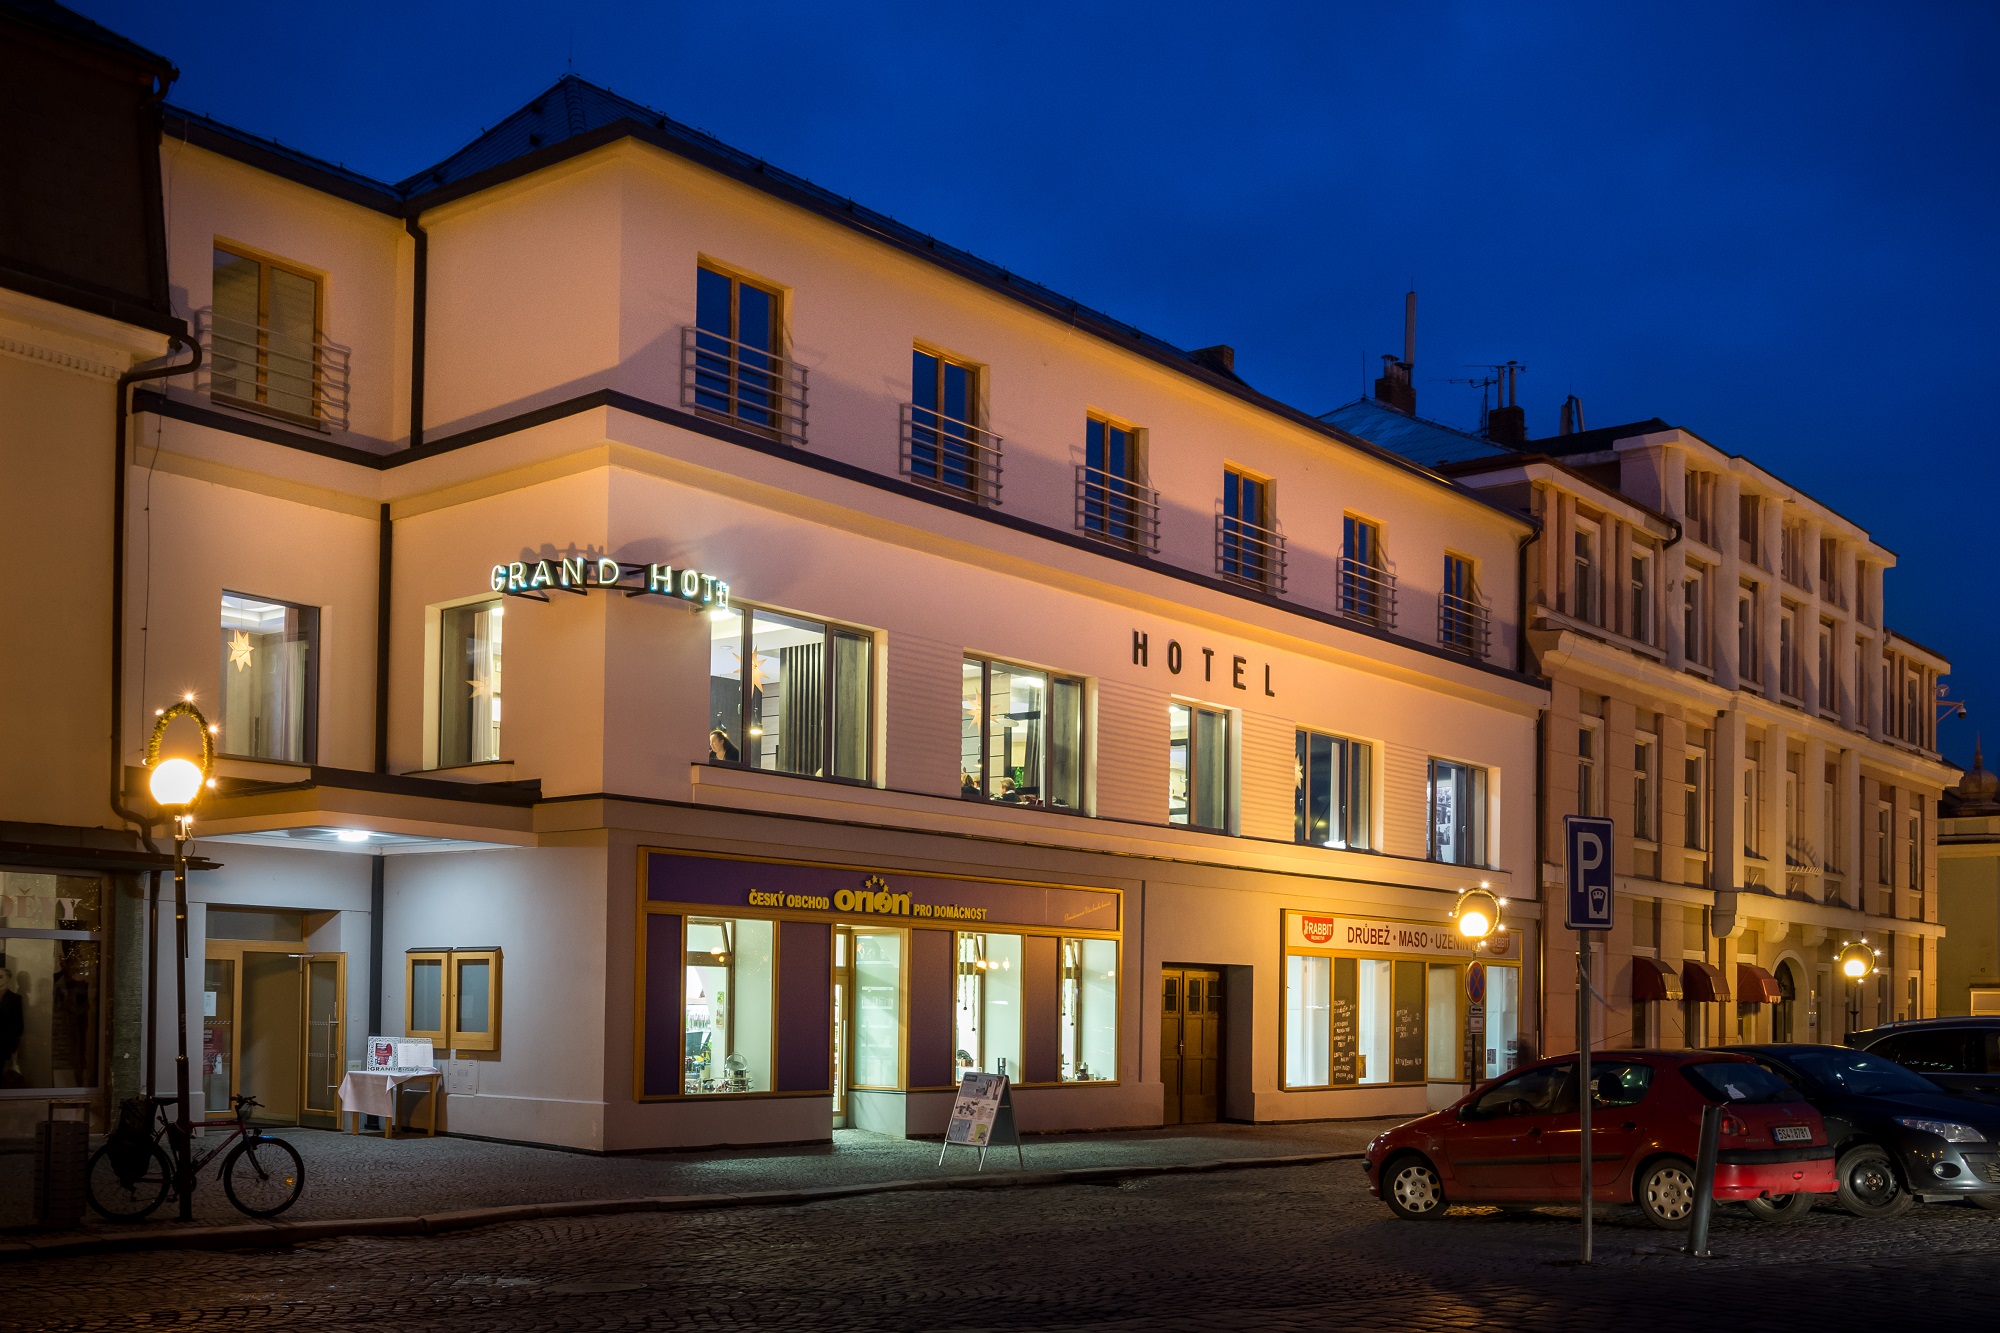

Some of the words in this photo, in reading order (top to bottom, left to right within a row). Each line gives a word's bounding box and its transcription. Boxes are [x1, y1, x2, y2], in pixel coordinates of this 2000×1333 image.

[490, 556, 621, 592] GRAND
[1132, 629, 1276, 698] HOTEL
[1577, 831, 1604, 893] P
[748, 888, 785, 907] ČESKÝ
[786, 894, 830, 910] OBCHOD
[913, 903, 932, 917] PRO
[933, 903, 988, 920] DOMÁCNOST
[1308, 921, 1333, 936] RABBIT
[1347, 922, 1391, 946] DRŮBEŽ
[1398, 930, 1428, 948] MASO
